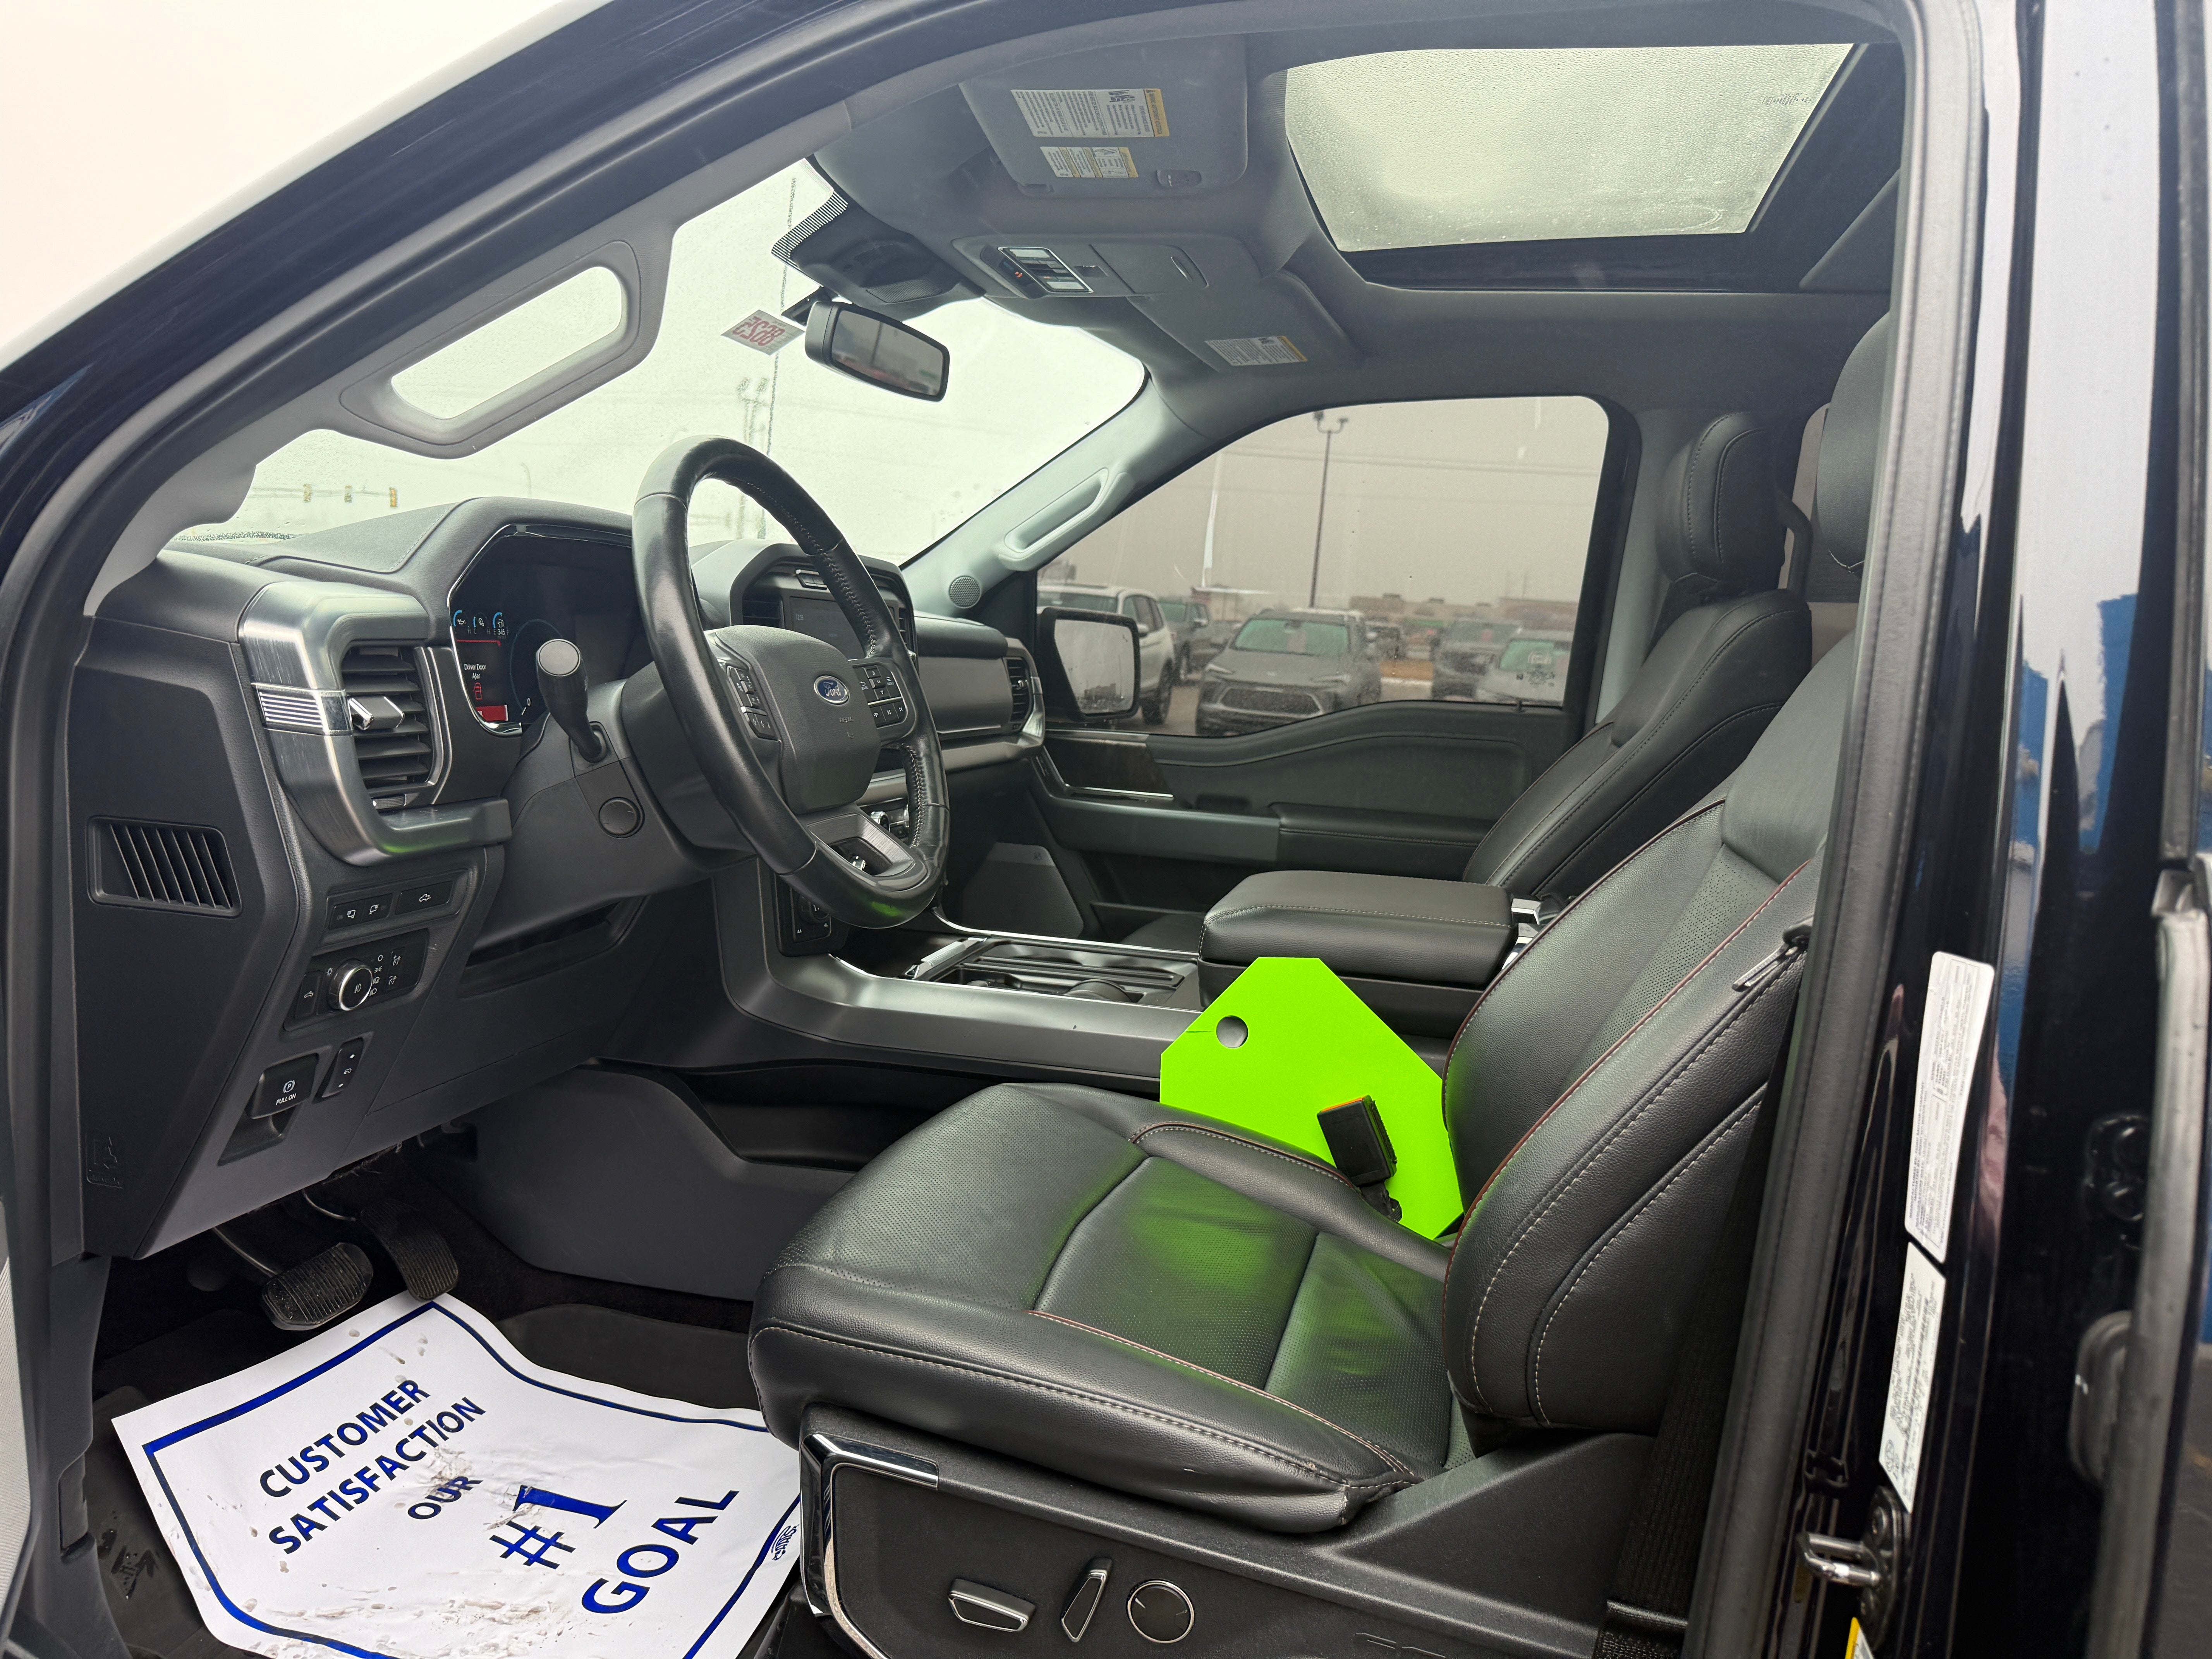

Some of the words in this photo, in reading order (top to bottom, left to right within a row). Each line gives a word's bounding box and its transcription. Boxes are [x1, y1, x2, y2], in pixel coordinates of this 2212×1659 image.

[823, 682, 841, 696] Ford
[276, 1096, 288, 1105] PULL
[260, 1380, 430, 1497] CUSTOMER
[269, 1396, 486, 1554] SATISFACTION
[407, 1476, 483, 1519] OUR
[489, 1485, 627, 1570] #1
[582, 1491, 740, 1614] GOAL
